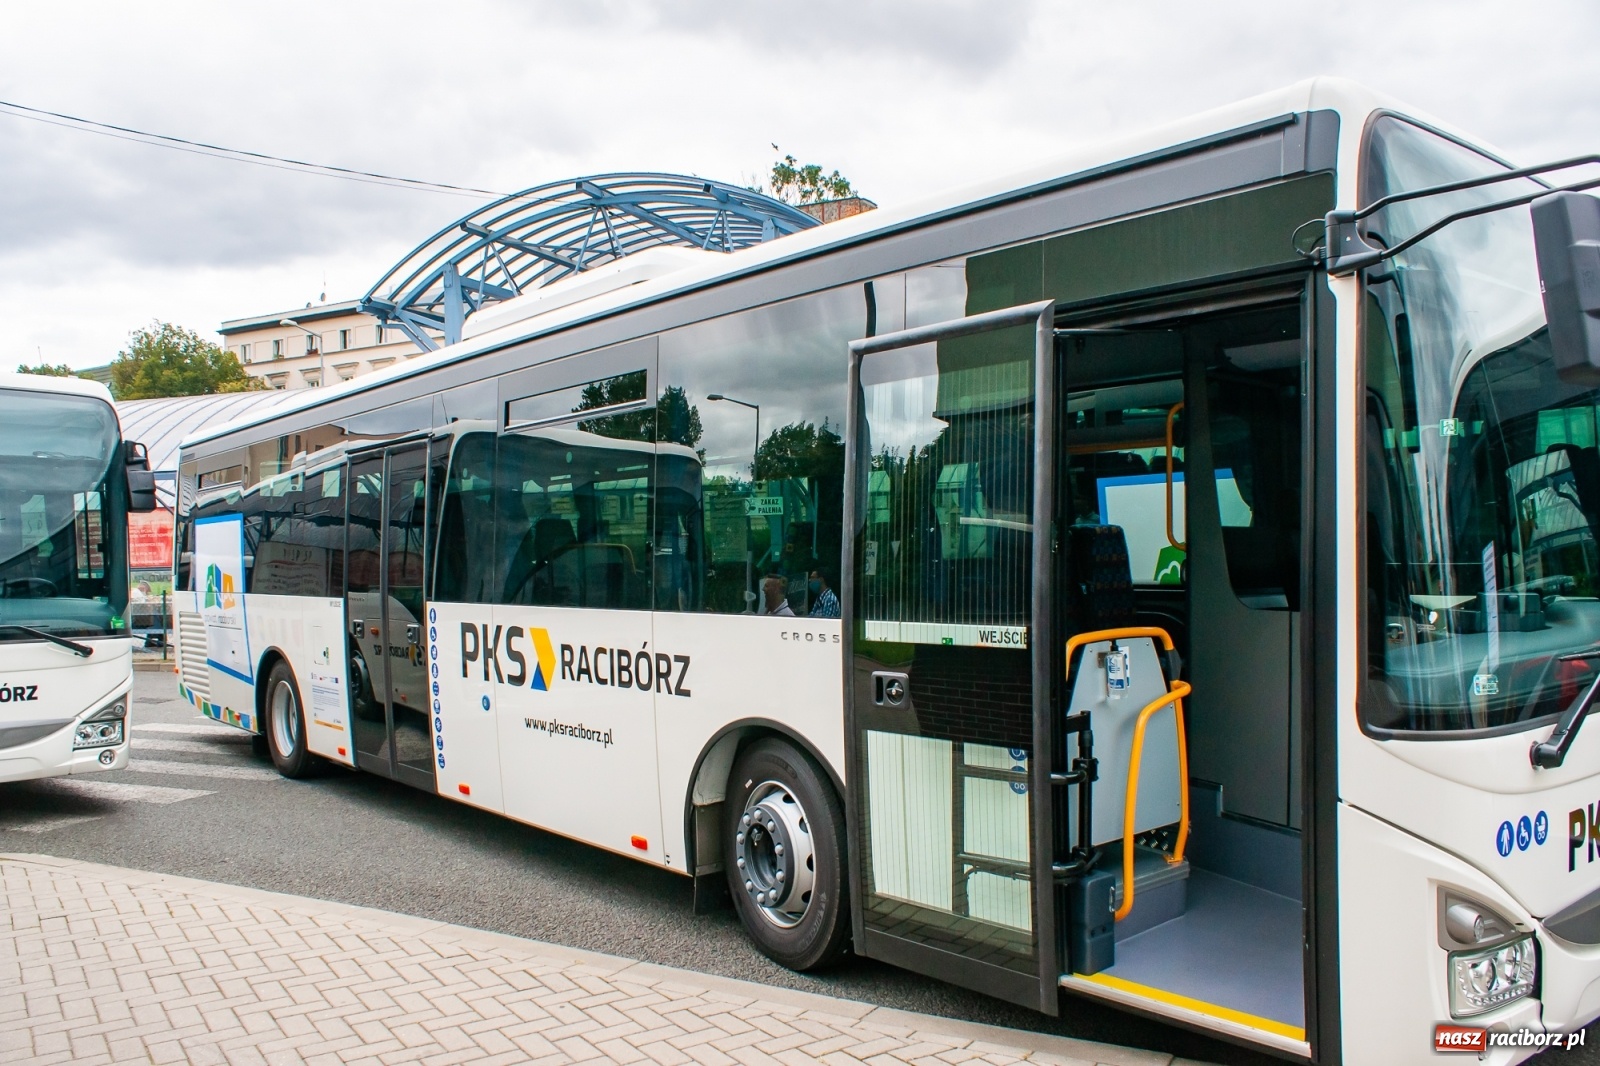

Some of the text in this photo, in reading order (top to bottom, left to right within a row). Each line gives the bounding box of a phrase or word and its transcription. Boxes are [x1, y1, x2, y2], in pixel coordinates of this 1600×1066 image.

[760, 498, 779, 506] ZAKAZ
[758, 506, 782, 514] PALENIA
[780, 631, 841, 644] CROSS
[460, 621, 692, 698] PKS RACIBÓRZ
[524, 717, 614, 749] www.pksraciborz.pl
